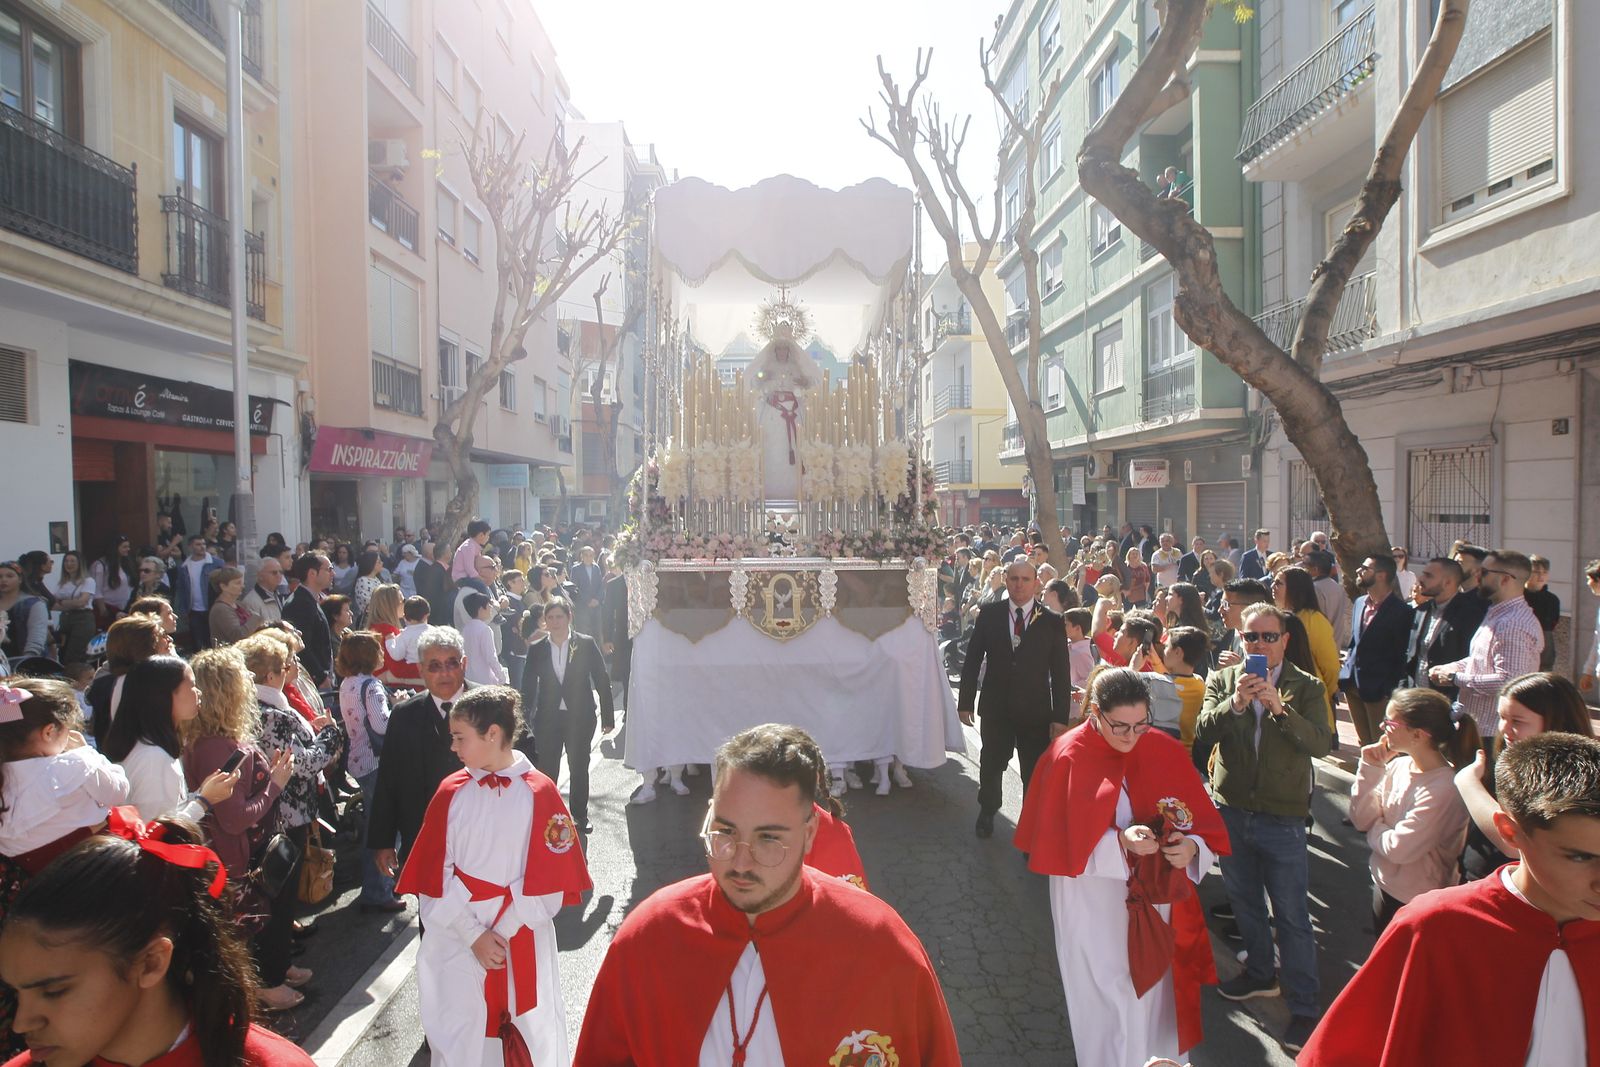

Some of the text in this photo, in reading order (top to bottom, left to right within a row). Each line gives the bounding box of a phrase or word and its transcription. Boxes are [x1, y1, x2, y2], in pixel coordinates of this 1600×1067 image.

[130, 407, 151, 418] Lounge
[1552, 420, 1566, 434] 24
[330, 443, 420, 472] INSPIRAZZIÓNE
